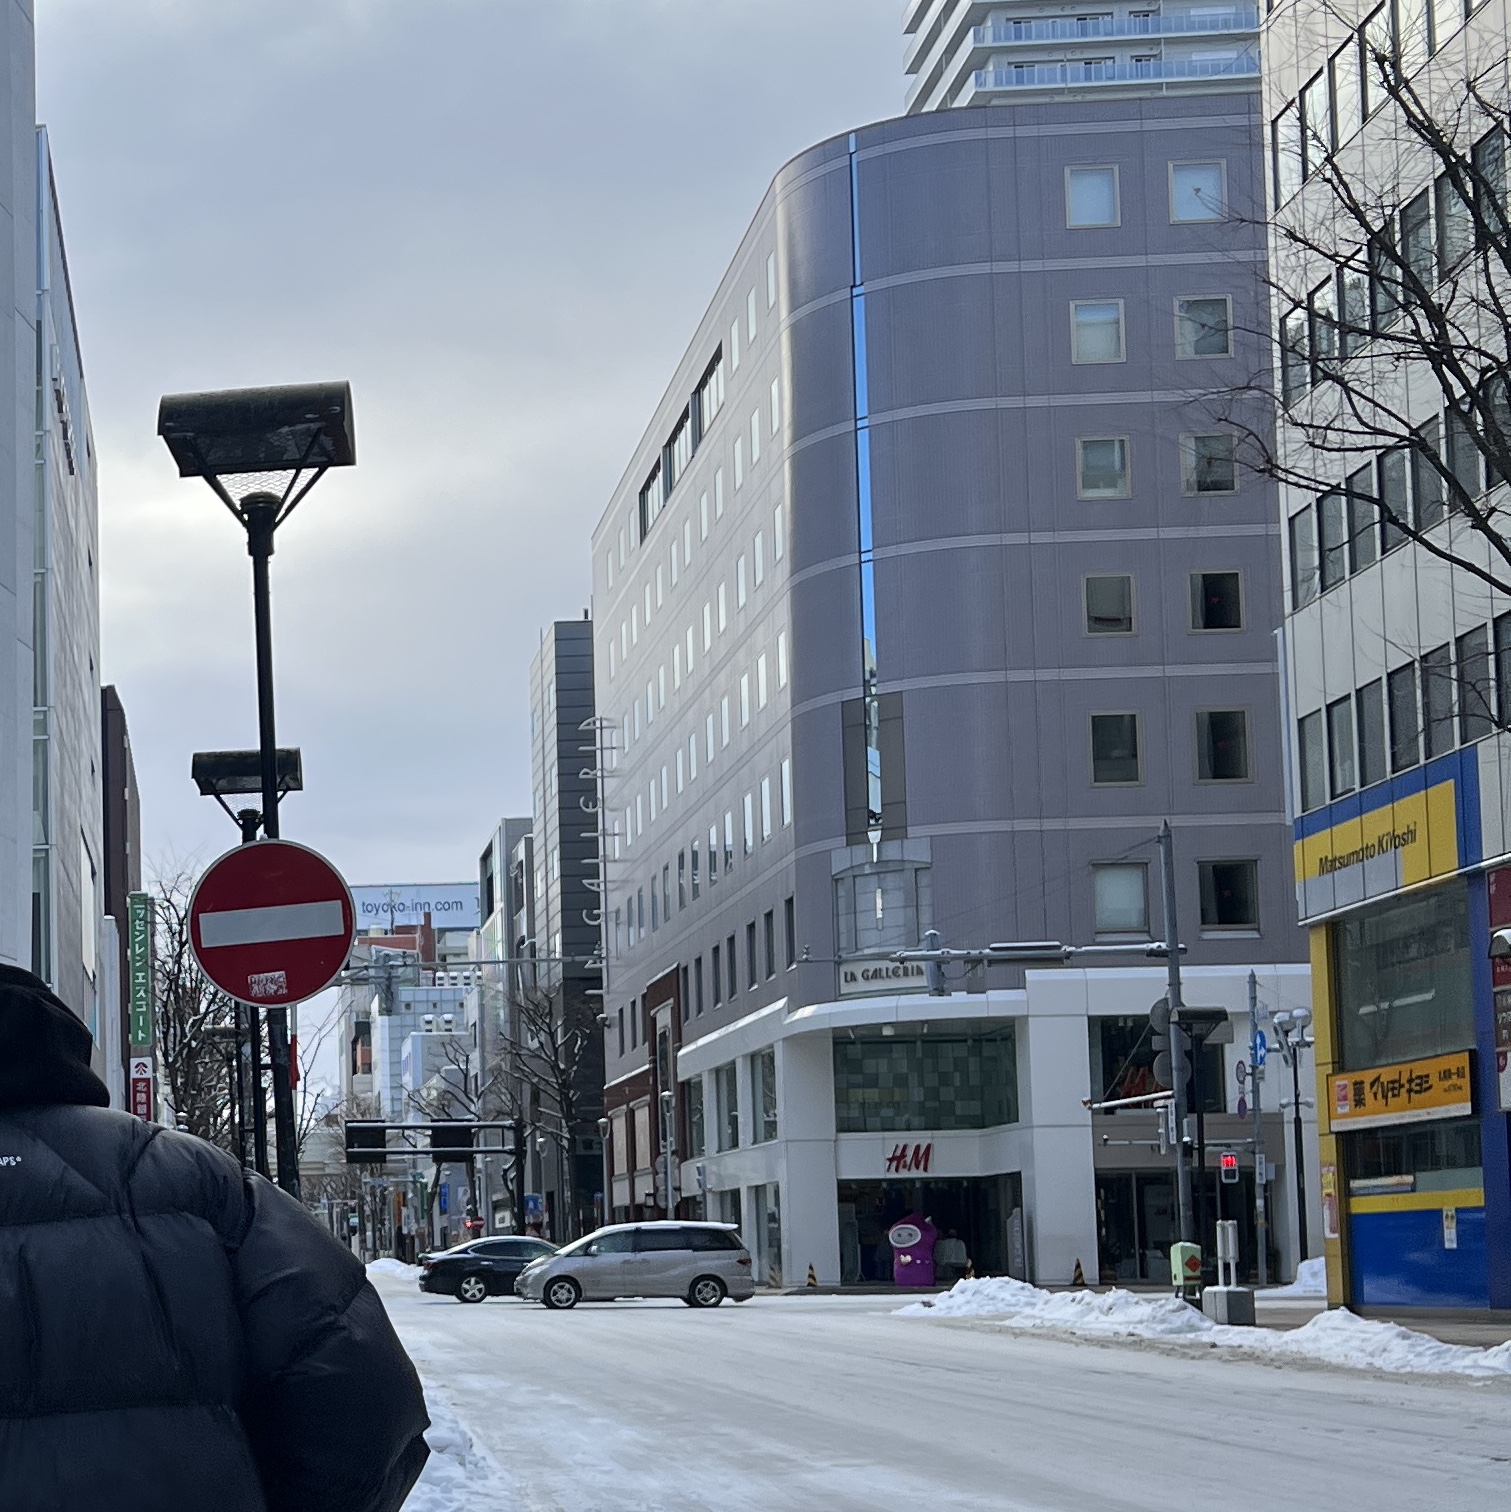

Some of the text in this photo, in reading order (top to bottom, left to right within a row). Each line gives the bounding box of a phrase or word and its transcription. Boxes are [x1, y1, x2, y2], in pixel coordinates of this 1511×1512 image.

[1318, 842, 1376, 877] Matsumoto
[361, 900, 464, 916] toyoko-inn.com
[844, 964, 925, 983] LA GALLERIA
[134, 972, 147, 1042] エスコート
[886, 1143, 932, 1173] H&M
